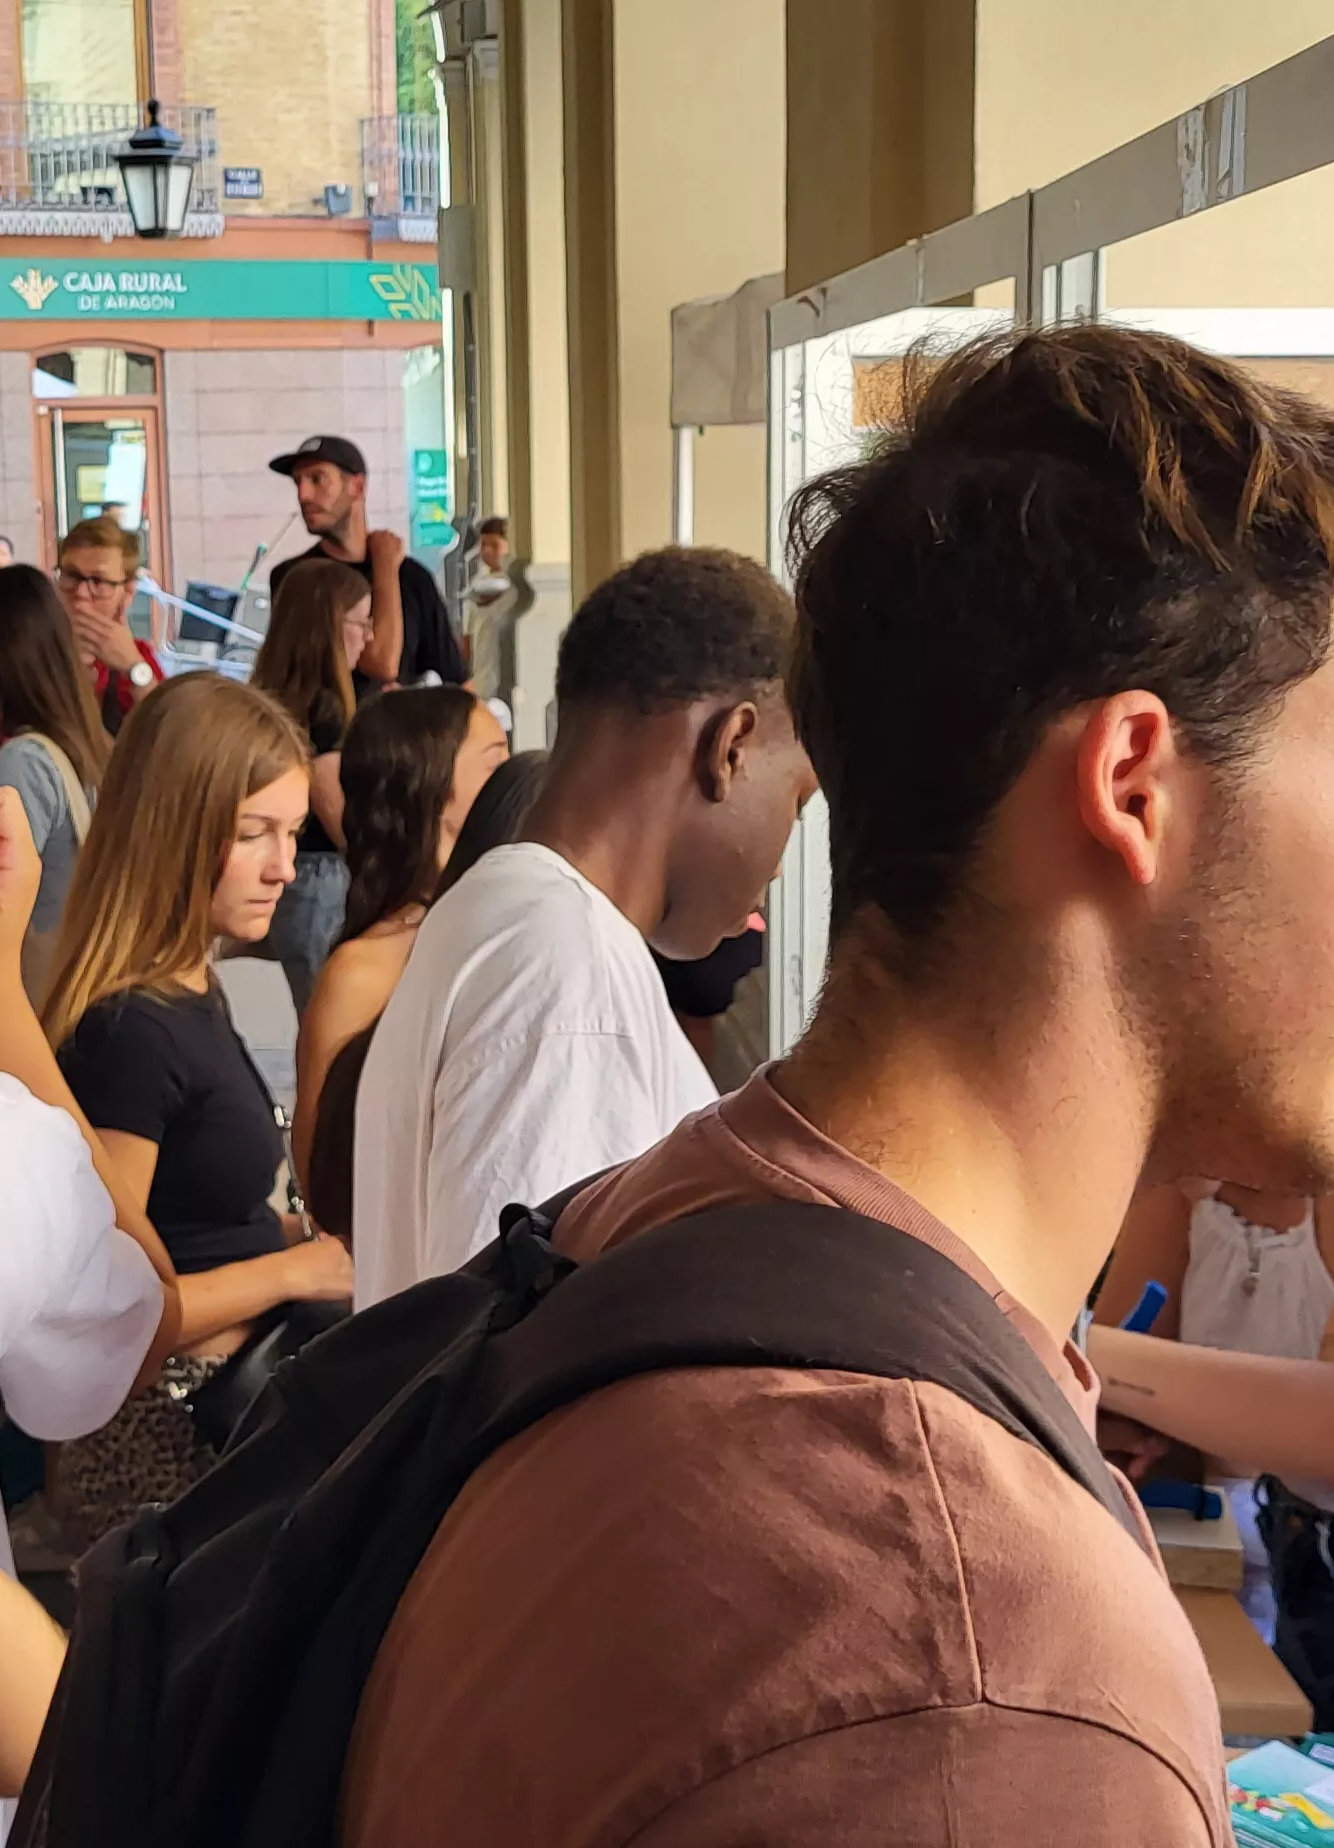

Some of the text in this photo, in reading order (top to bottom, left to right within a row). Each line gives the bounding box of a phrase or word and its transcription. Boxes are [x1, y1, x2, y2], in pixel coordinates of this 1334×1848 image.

[63, 272, 187, 292] CAJA RURAL
[79, 296, 99, 310] DE
